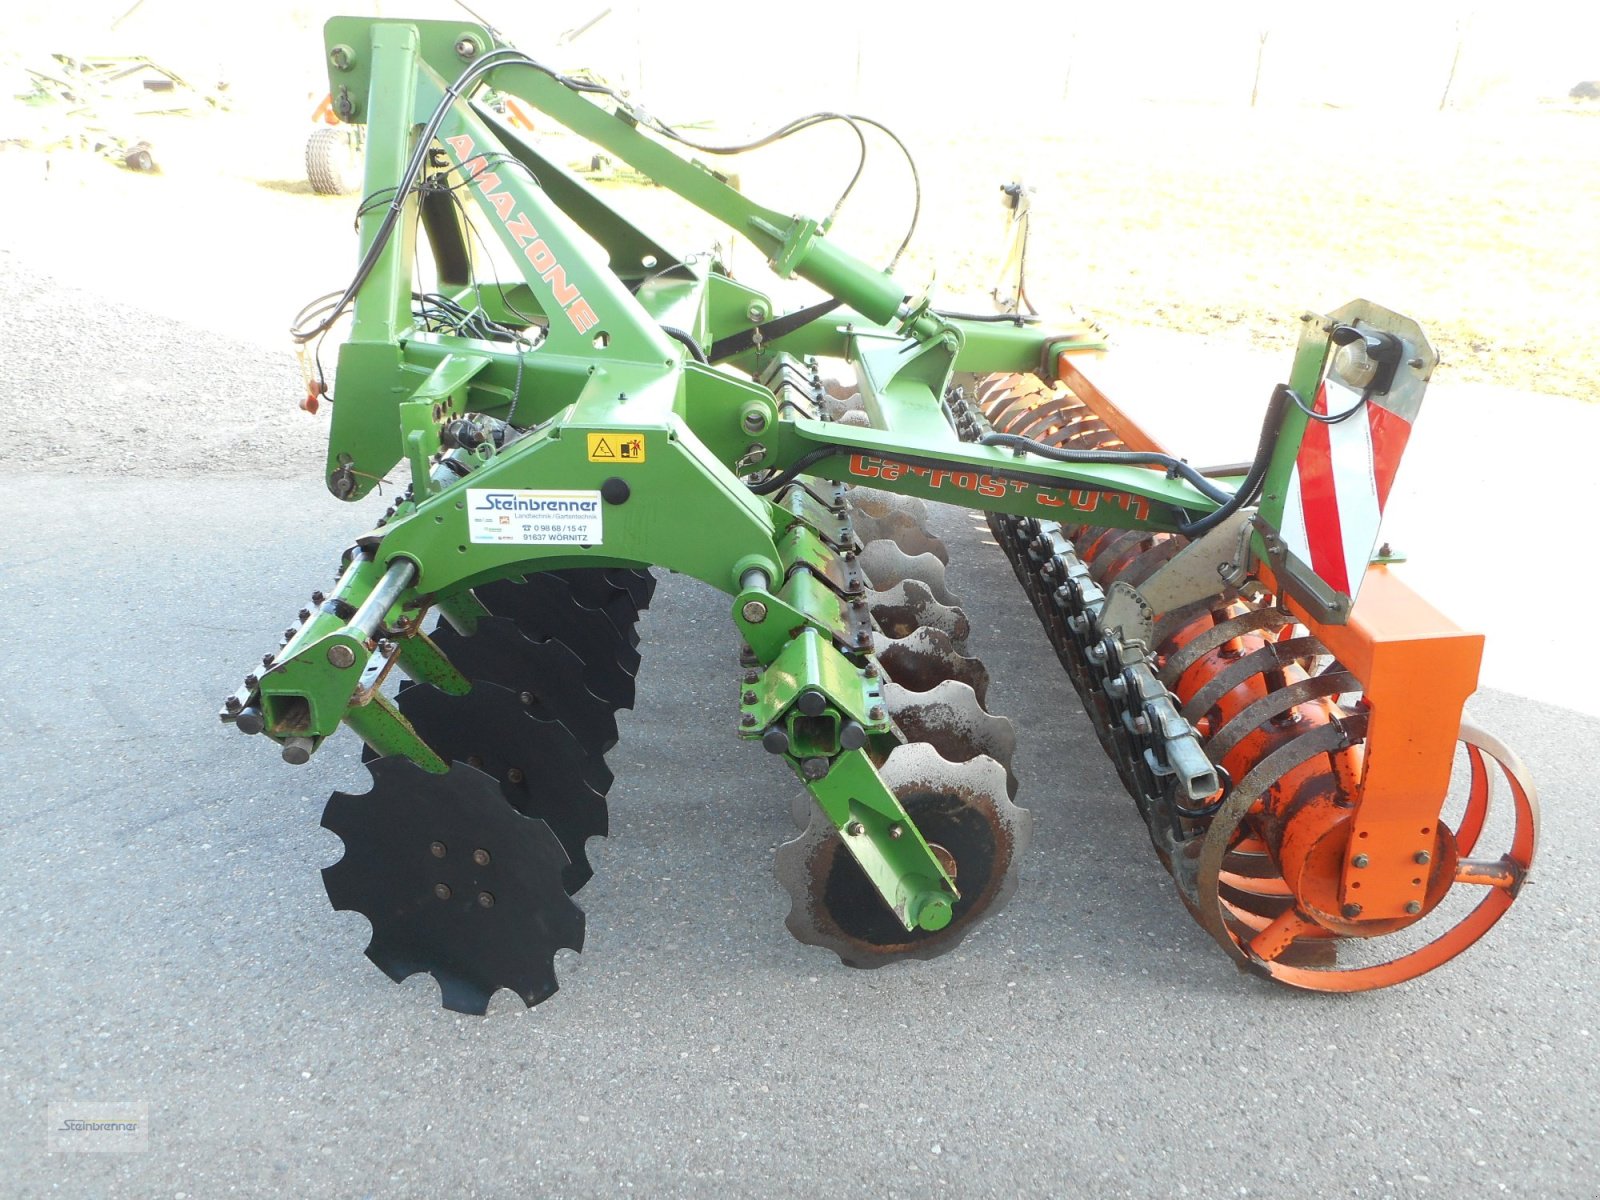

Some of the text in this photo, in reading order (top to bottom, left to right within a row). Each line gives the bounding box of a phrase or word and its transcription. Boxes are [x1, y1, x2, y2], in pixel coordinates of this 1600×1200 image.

[446, 134, 600, 335] AMAZONE
[475, 493, 598, 511] Steinbrenner
[548, 532, 589, 541] WÖRNITZ
